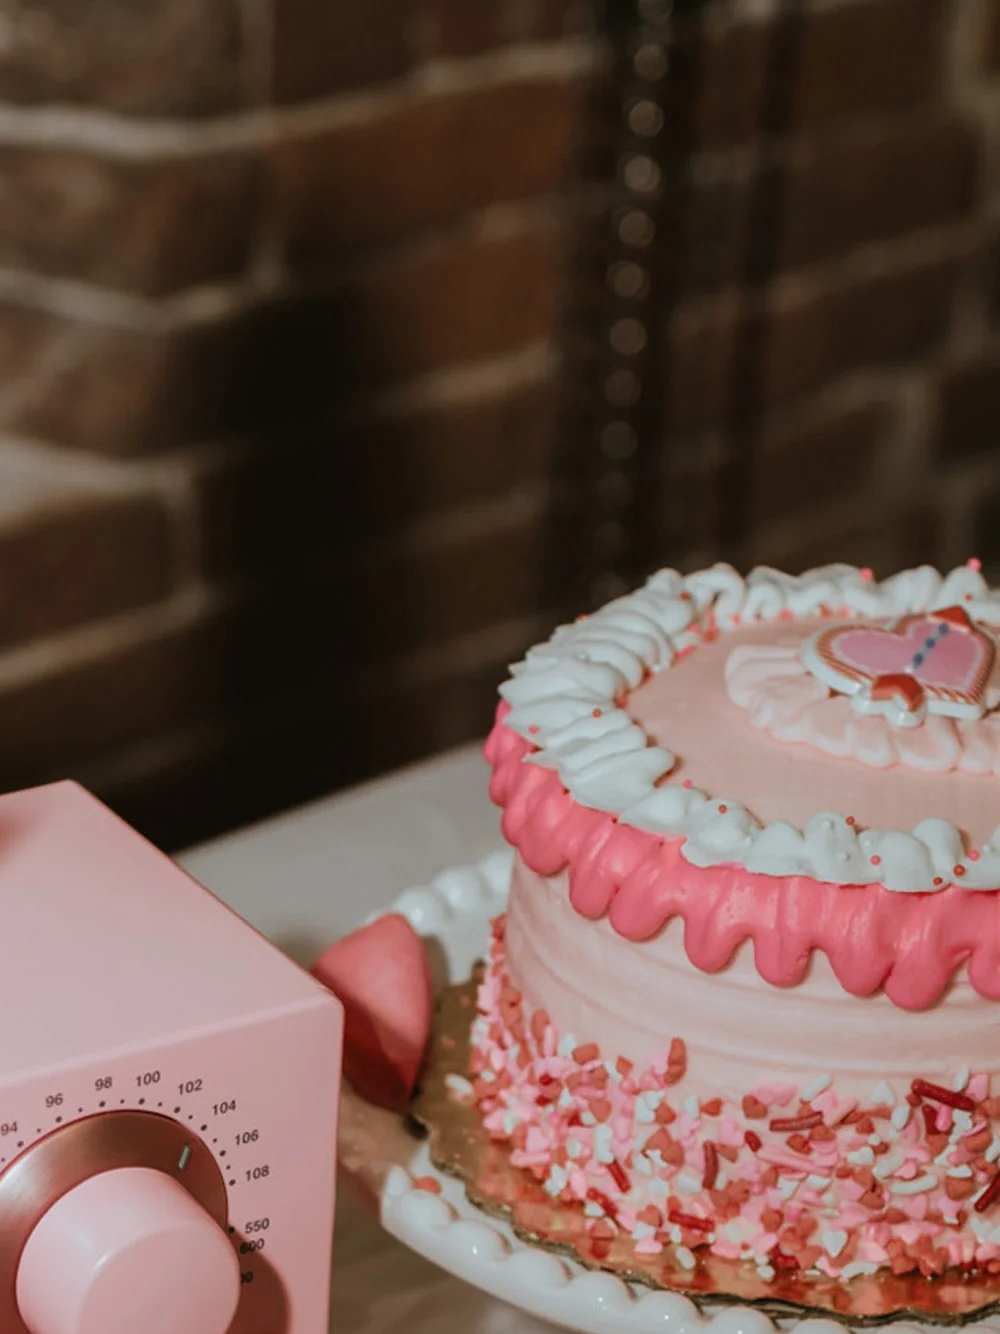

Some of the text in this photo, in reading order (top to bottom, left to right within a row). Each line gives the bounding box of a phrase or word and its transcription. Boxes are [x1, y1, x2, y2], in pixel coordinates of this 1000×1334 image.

[94, 1076, 113, 1092] 98
[136, 1070, 161, 1088] 100
[178, 1078, 203, 1096] 102
[45, 1092, 64, 1109] 96
[212, 1099, 237, 1116] 104
[0, 1121, 18, 1136] 94
[235, 1129, 260, 1146] 106
[245, 1164, 270, 1182] 108
[244, 1217, 270, 1235] 550
